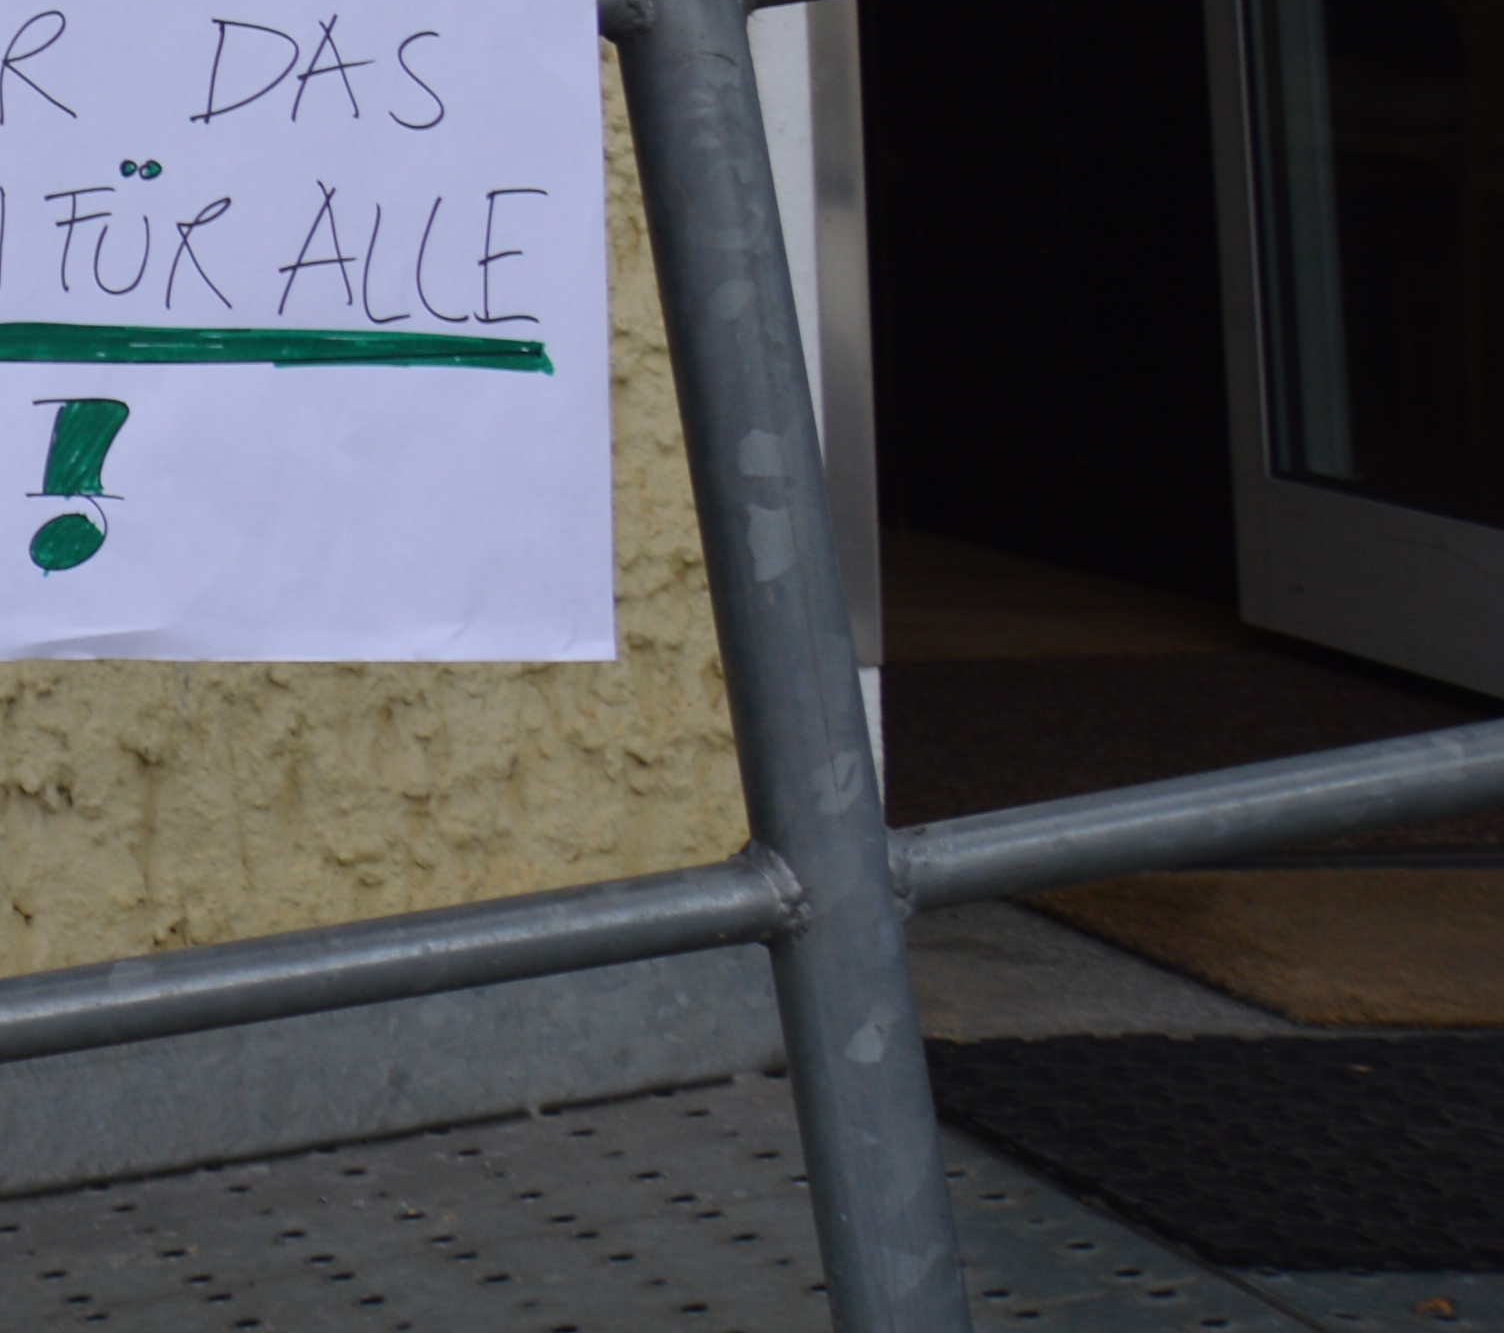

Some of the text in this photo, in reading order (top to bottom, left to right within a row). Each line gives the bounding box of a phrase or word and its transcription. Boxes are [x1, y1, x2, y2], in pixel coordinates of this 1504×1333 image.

[189, 13, 446, 130] DAS
[44, 157, 233, 310] FÜR
[277, 179, 549, 325] ALLE
